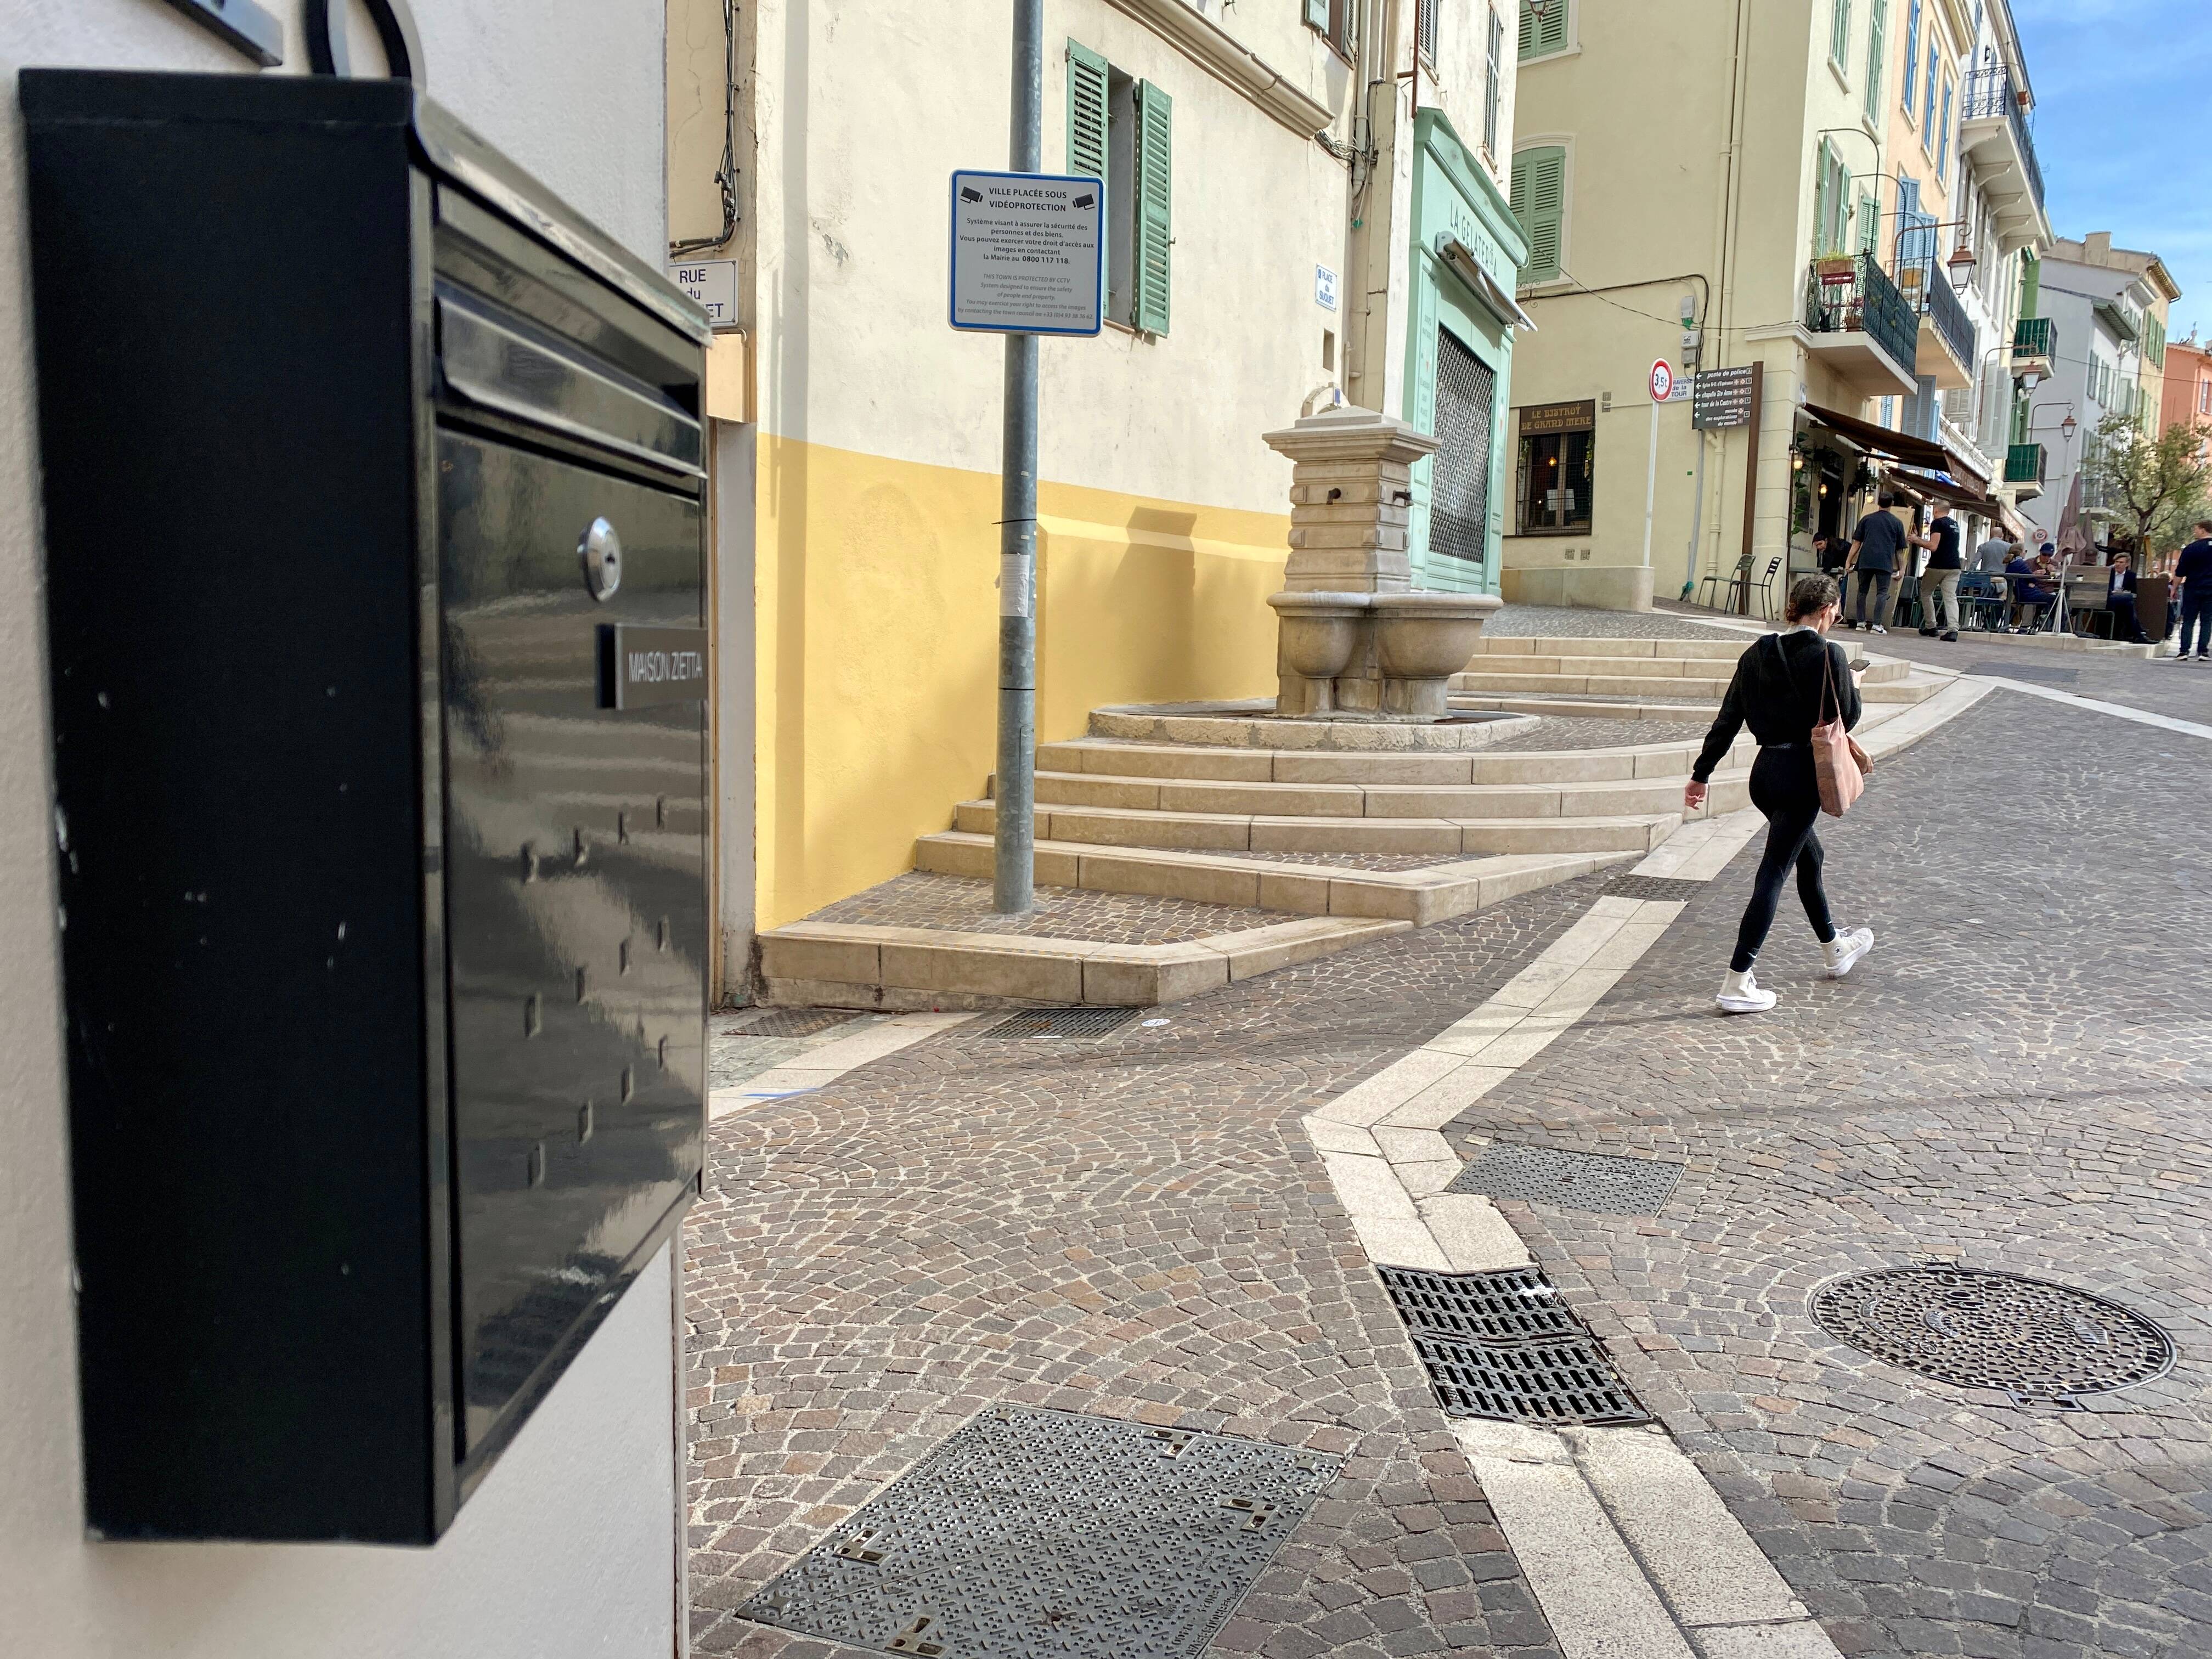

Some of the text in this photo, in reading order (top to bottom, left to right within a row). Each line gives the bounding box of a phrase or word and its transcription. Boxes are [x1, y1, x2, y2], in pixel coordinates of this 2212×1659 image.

[1013, 189, 1043, 197] PLACÉE
[1045, 190, 1066, 199] SOUS
[989, 200, 1066, 211] VIDÉOPROTECTION
[1451, 199, 1459, 234] LA
[679, 268, 706, 283] RUE
[1730, 369, 1746, 377] police
[1532, 409, 1541, 419] LE
[1521, 421, 1532, 431] DE
[1534, 418, 1564, 430] GRAND
[629, 651, 703, 682] MAISON ZETTA
